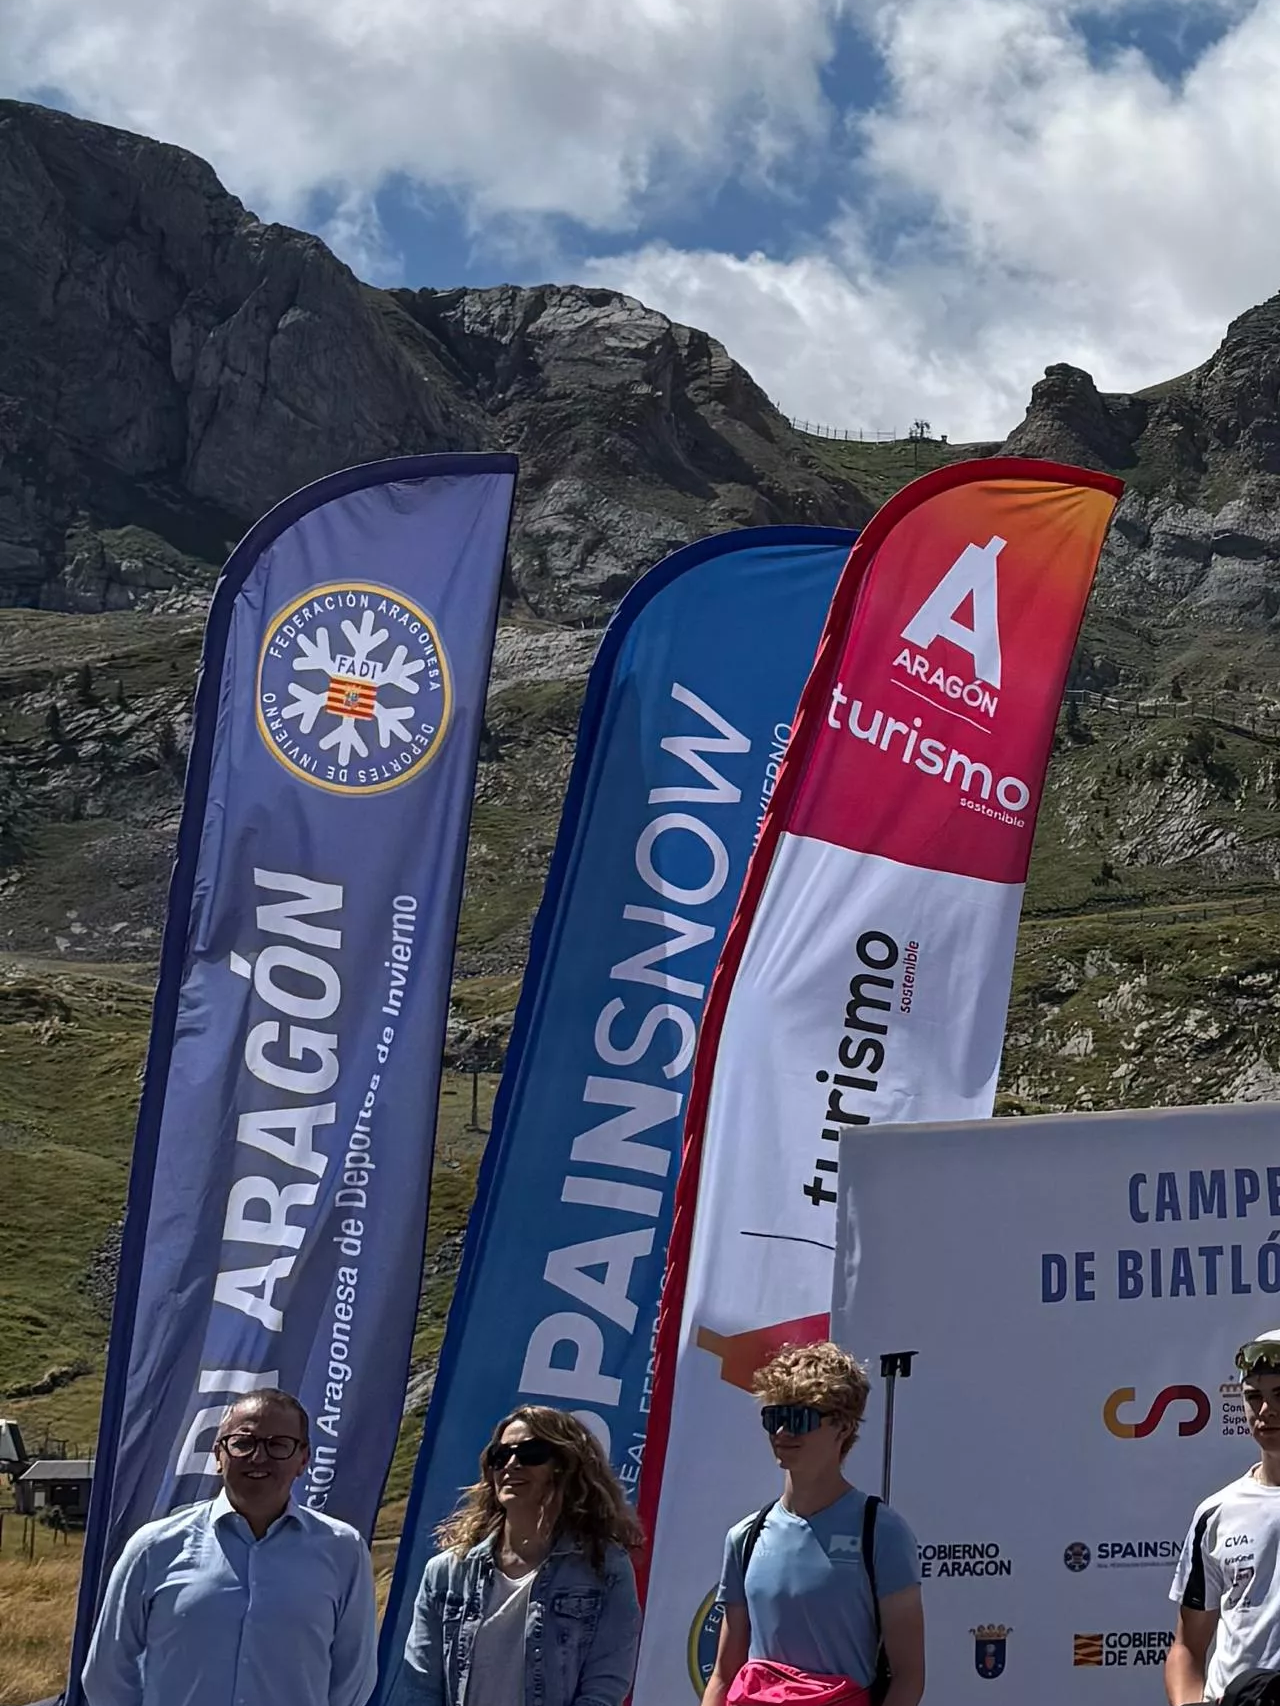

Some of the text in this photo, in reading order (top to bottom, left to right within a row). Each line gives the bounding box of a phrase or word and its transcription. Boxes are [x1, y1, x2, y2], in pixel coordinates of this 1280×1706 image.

[269, 590, 441, 692] FEDERACIÓN ARAGONESA
[338, 657, 378, 680] FADI
[892, 648, 999, 718] ARAGÓN
[263, 692, 317, 773] INVIERNO
[358, 723, 434, 783] DEPORTES
[827, 682, 1030, 812] turismo
[326, 765, 348, 782] DE
[960, 797, 1026, 828] sostenible
[381, 894, 418, 1018] Invierno
[900, 940, 920, 1014] sostenible
[376, 1026, 395, 1064] de
[213, 867, 344, 1332] ARAGÓN
[336, 1217, 364, 1256] de
[1041, 1250, 1097, 1304] DE
[317, 1266, 359, 1437] Aragonesa
[937, 1560, 1012, 1577] ARAGON
[1225, 1536, 1249, 1549] CVA
[1104, 1650, 1128, 1666] DE
